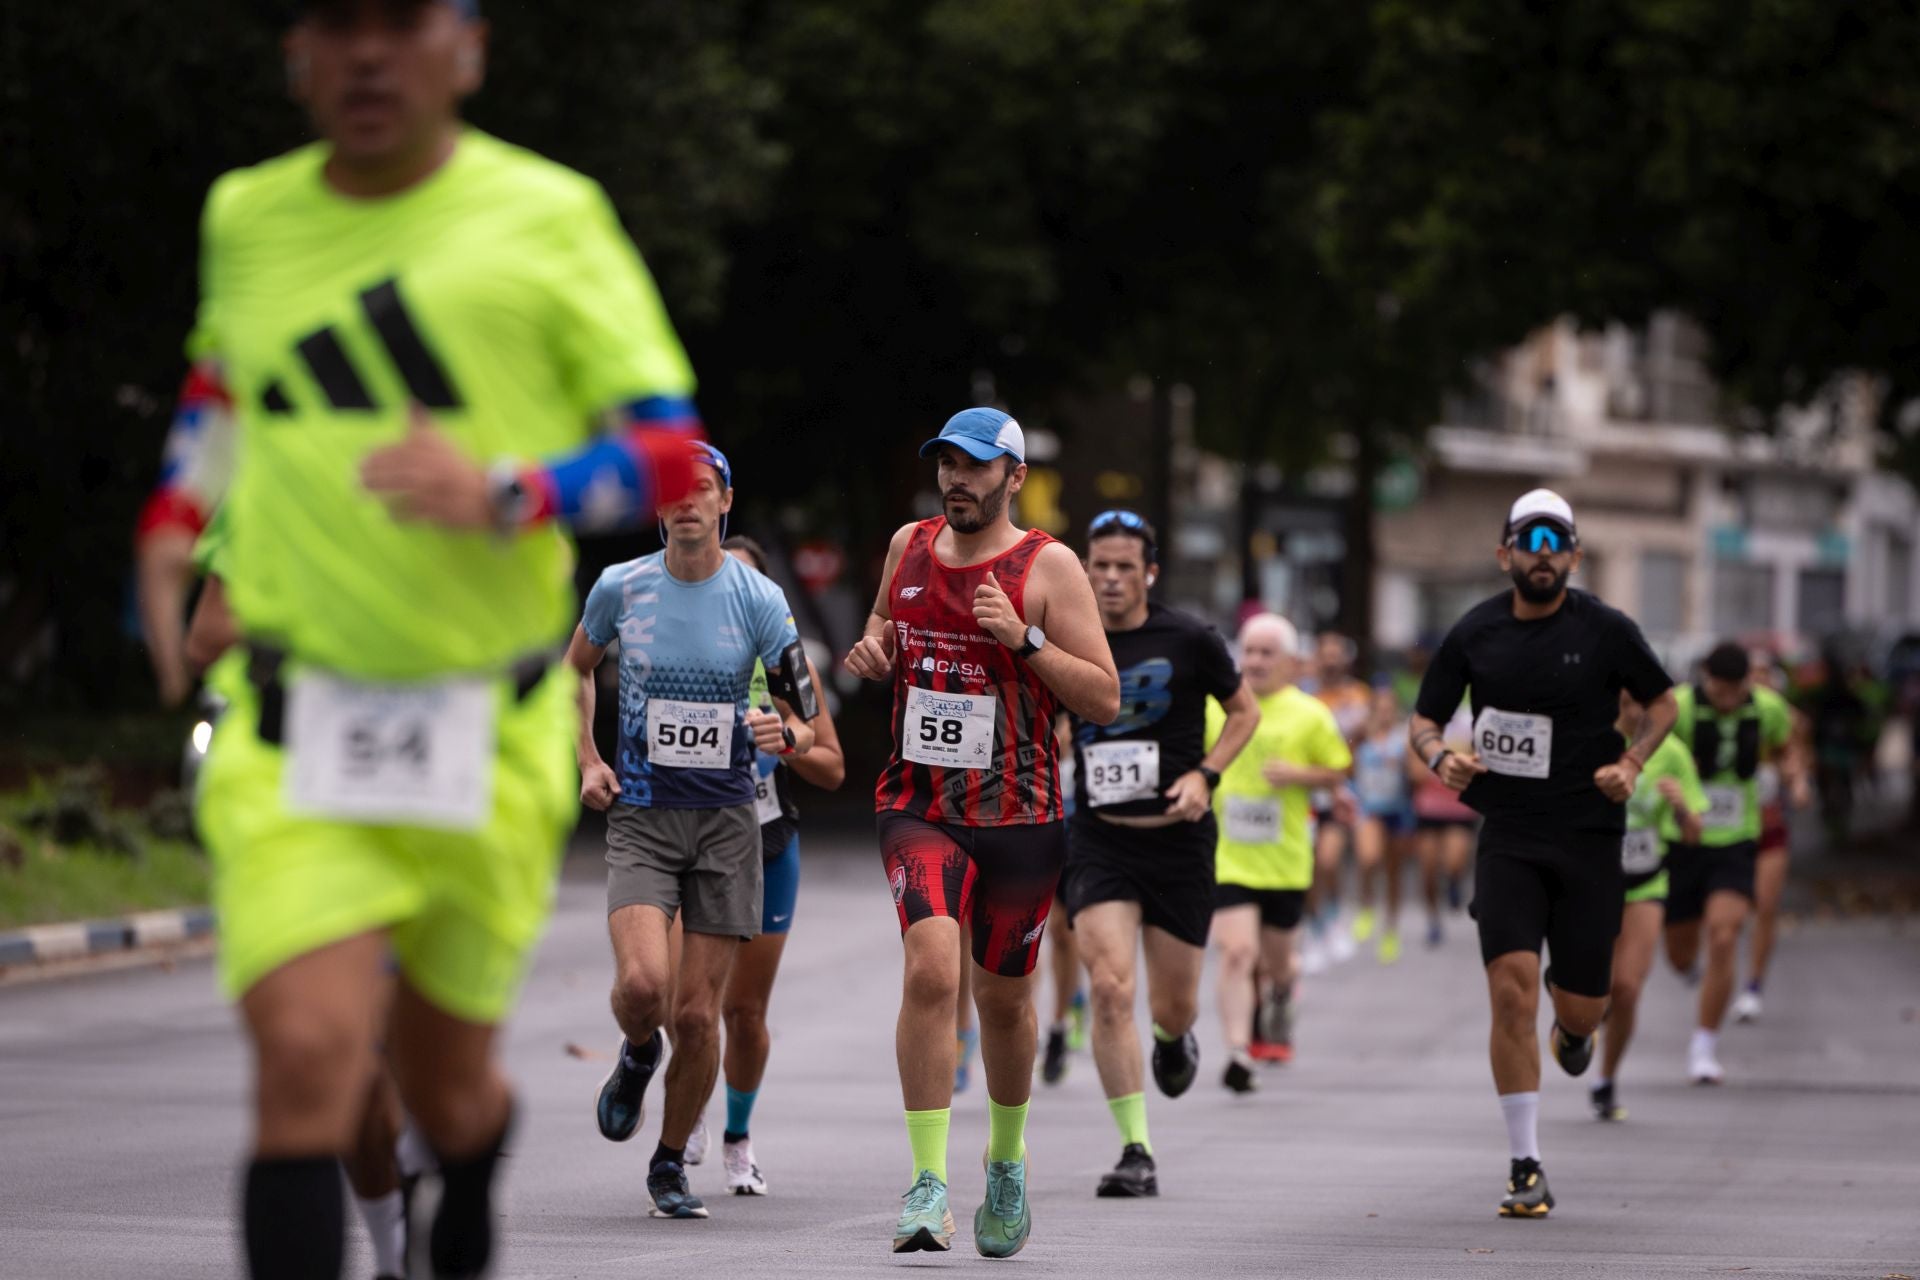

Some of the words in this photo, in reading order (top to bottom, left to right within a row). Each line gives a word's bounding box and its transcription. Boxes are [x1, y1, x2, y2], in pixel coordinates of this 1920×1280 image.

[908, 636, 926, 647] Área
[927, 641, 936, 649] de
[938, 641, 967, 652] Deporte
[909, 626, 958, 640] Ayuntamiento
[959, 633, 969, 641] de
[969, 634, 998, 645] Málaga
[936, 660, 986, 677] CASA
[960, 676, 986, 684] agency
[658, 723, 719, 748] 504
[920, 715, 963, 745] 58
[1482, 729, 1534, 757] 604
[1094, 763, 1141, 793] 931
